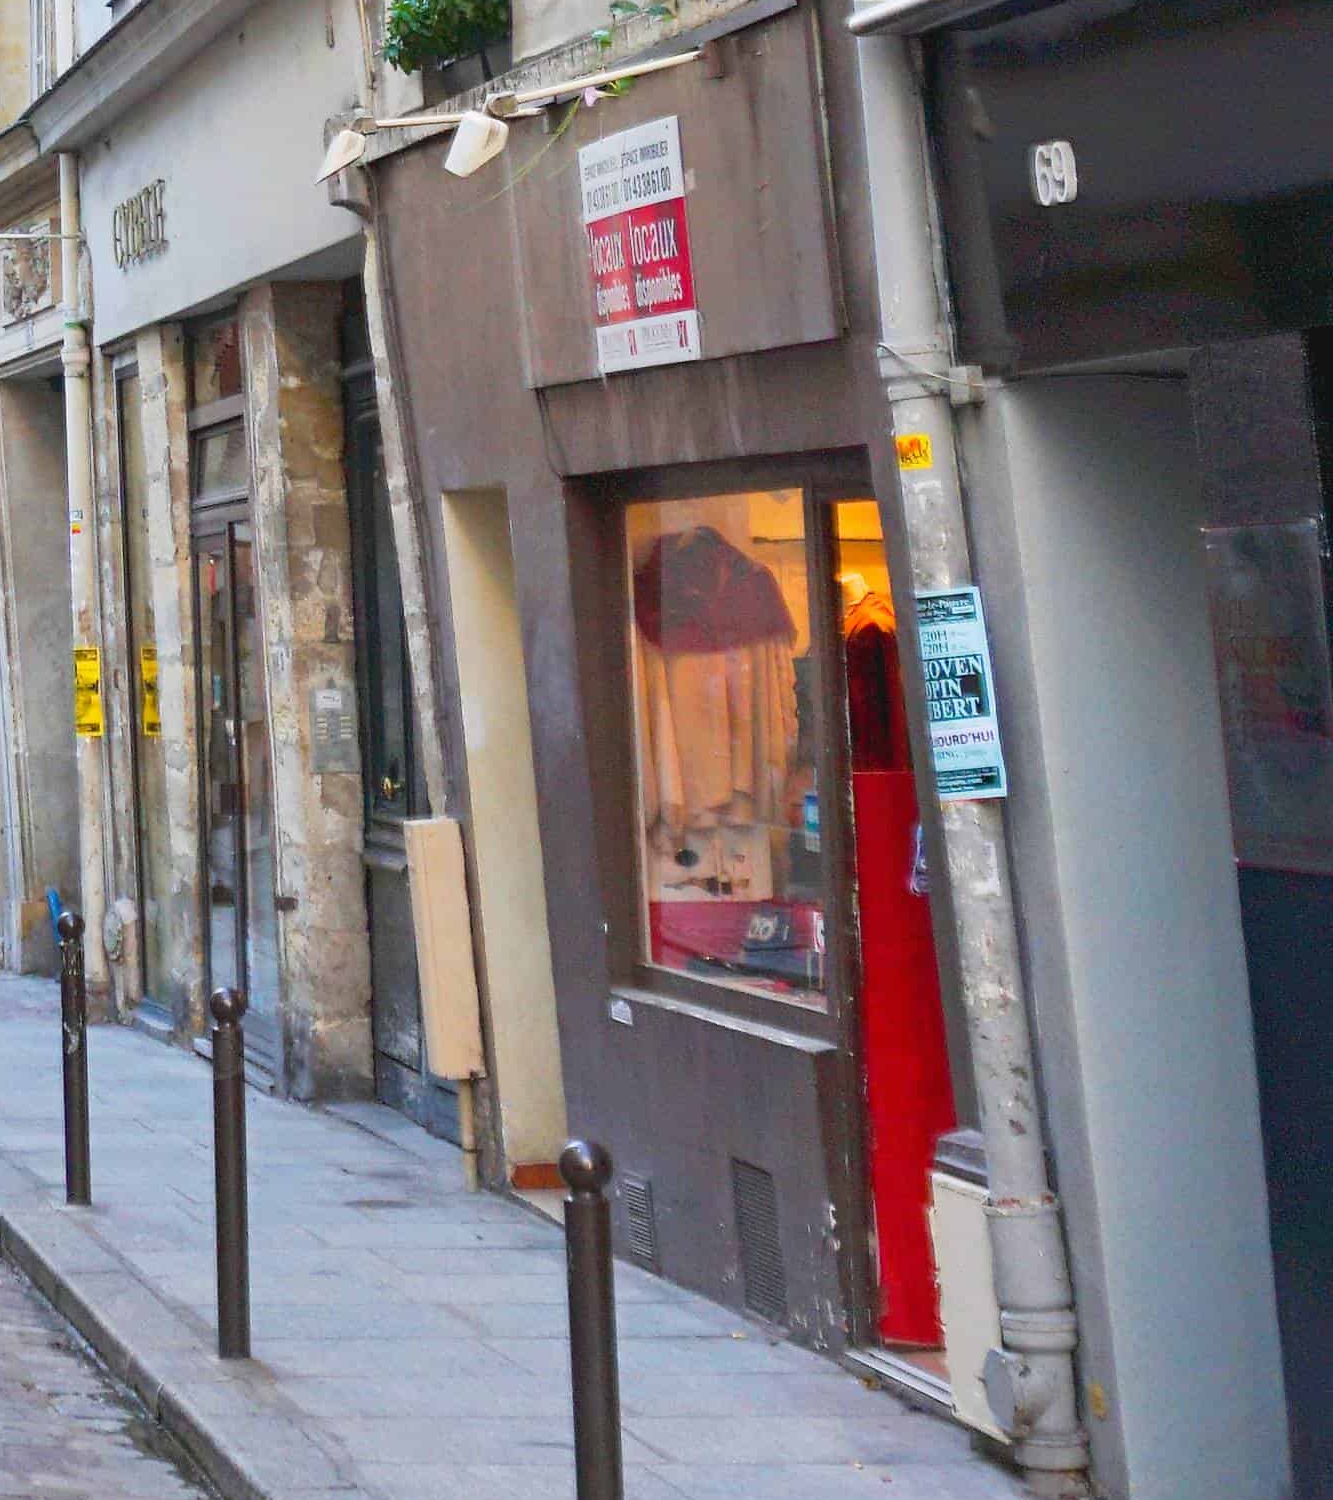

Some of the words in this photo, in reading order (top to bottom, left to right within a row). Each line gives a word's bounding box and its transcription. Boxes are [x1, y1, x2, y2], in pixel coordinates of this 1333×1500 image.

[1035, 140, 1077, 206] 69
[589, 228, 625, 277] locaux
[628, 215, 678, 265] locaux
[635, 267, 683, 312] disponibles
